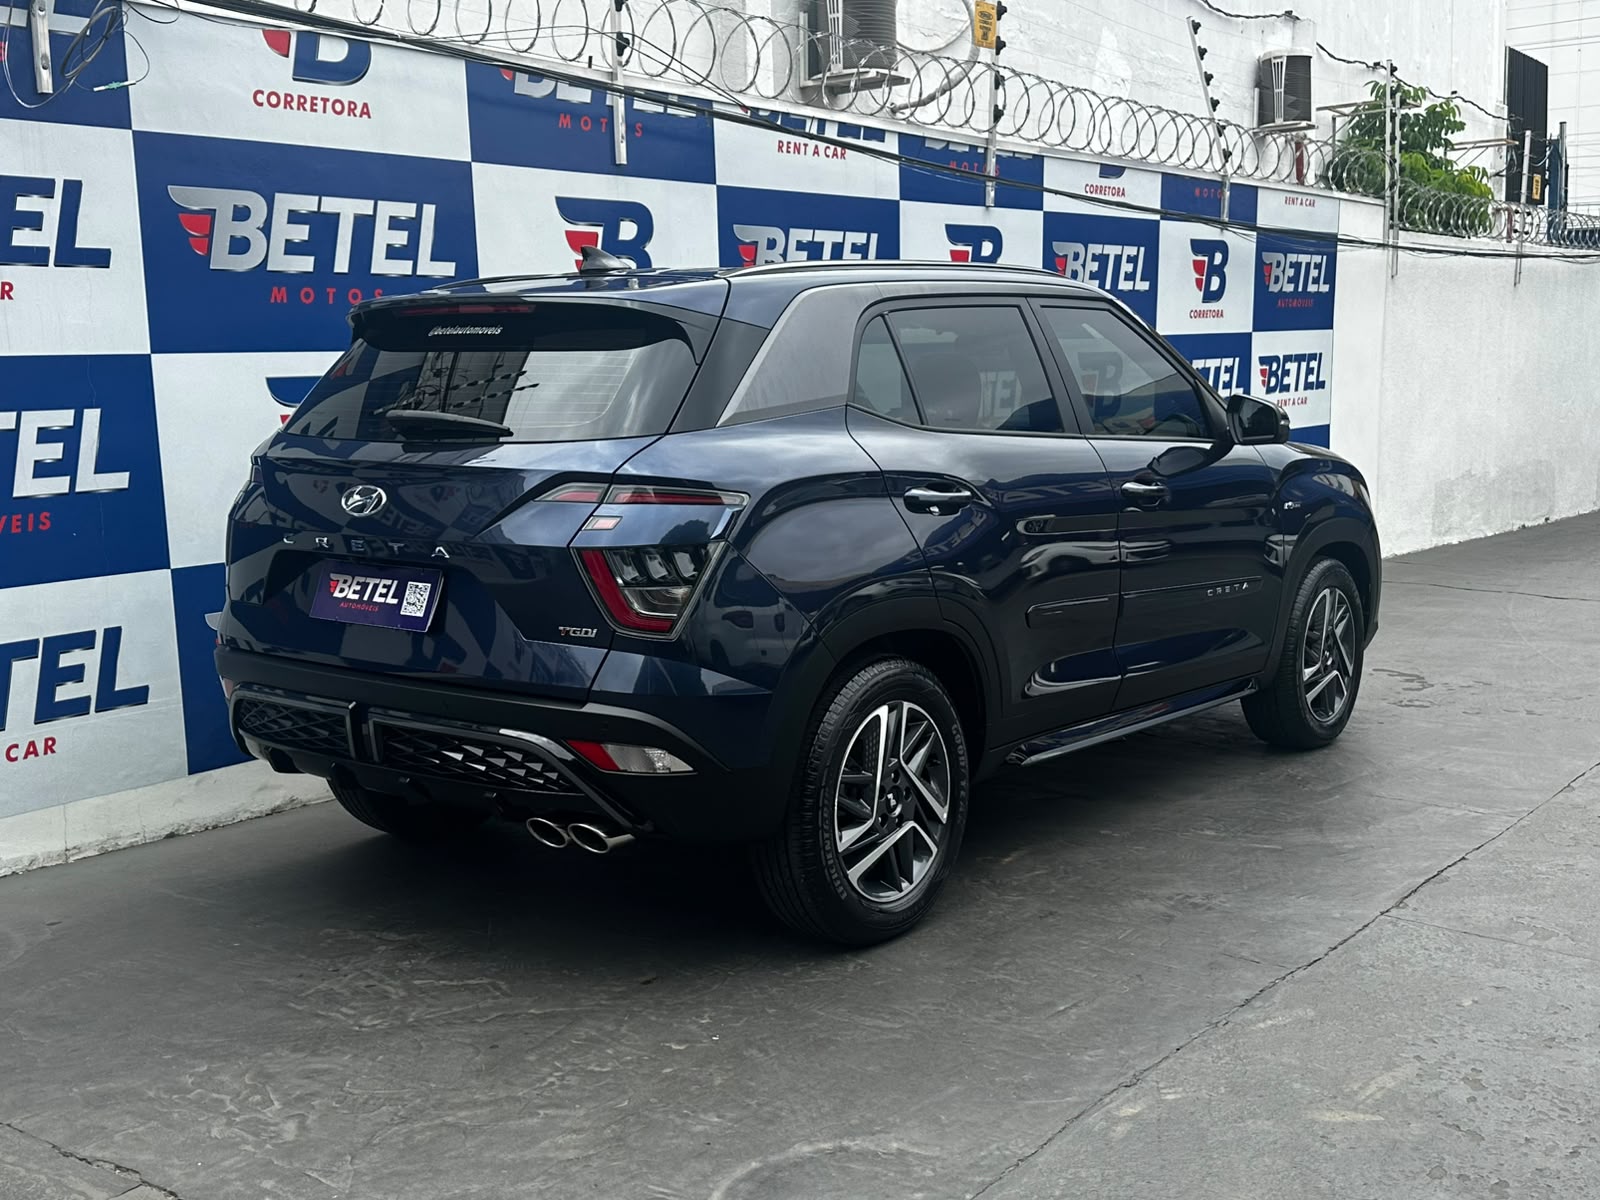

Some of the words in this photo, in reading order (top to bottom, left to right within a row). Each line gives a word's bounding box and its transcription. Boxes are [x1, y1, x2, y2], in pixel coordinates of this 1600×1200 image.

[253, 89, 372, 119] CORRETORA
[558, 113, 643, 138] MOTS
[777, 139, 810, 156] RENT
[812, 144, 820, 158] A
[824, 146, 847, 160] CAR
[1084, 183, 1126, 198] CORRETORA
[1194, 187, 1223, 199] MOTO
[167, 184, 456, 278] BETEL
[1052, 241, 1150, 291] BETEL
[1190, 238, 1229, 304] B
[1262, 252, 1330, 293] BETEL
[1189, 309, 1224, 319] CORRETORA
[1258, 352, 1326, 395] BETEL
[283, 533, 450, 558] CRETA
[329, 573, 399, 604] BETEL
[1207, 582, 1249, 597] CRETA
[5, 736, 57, 762] CAR
